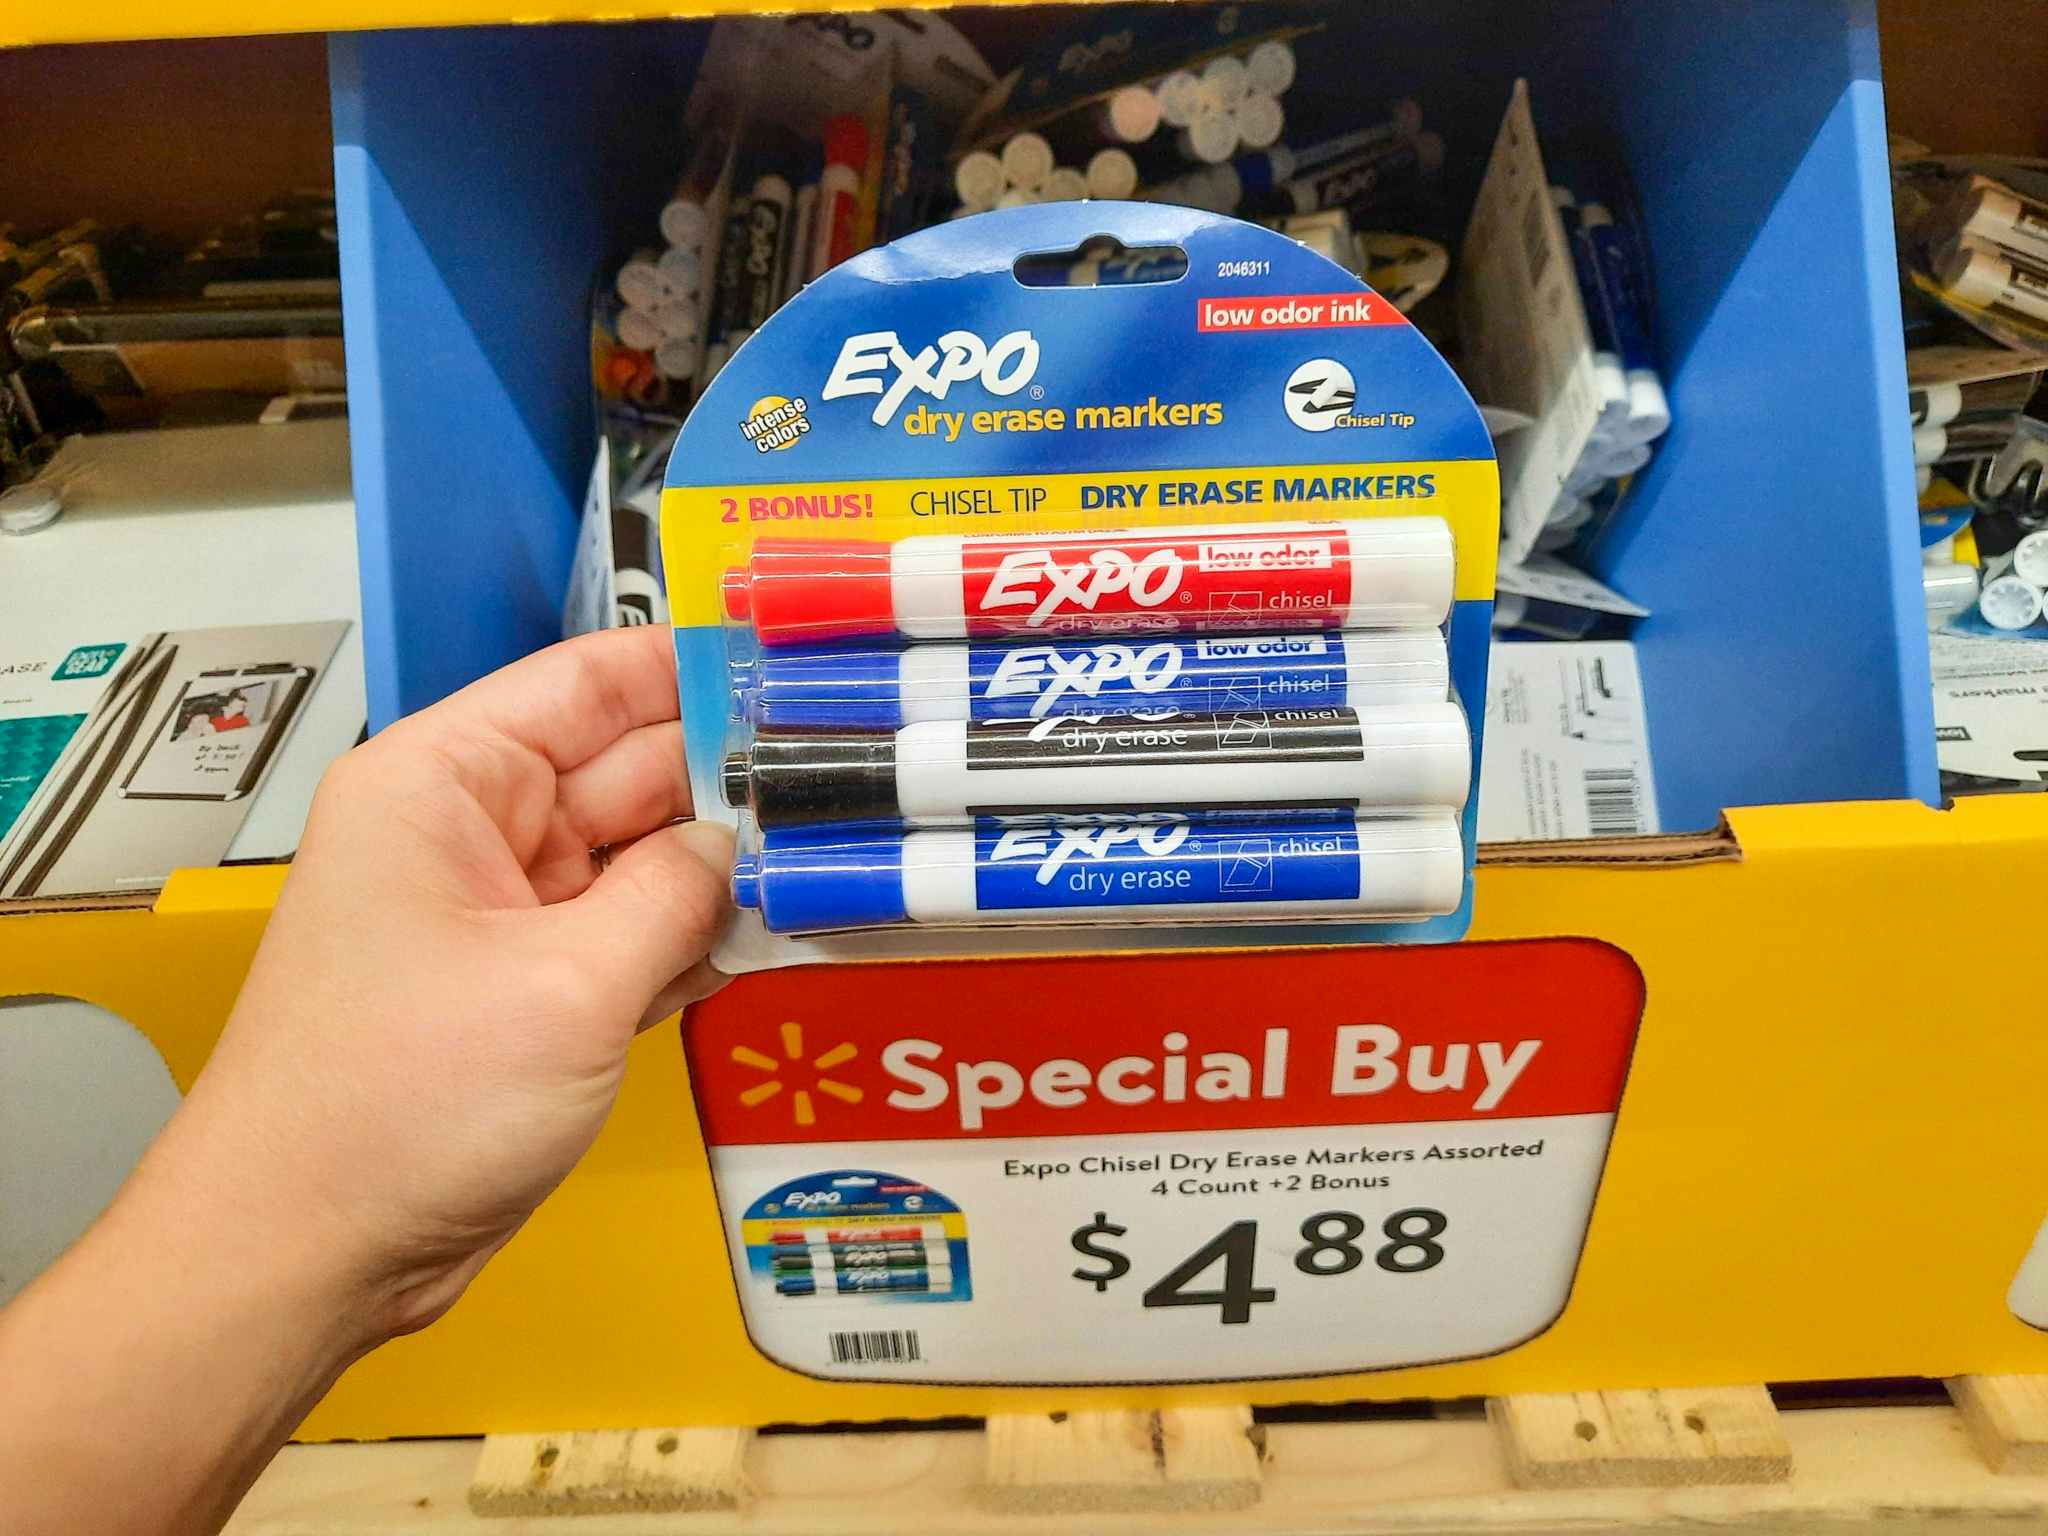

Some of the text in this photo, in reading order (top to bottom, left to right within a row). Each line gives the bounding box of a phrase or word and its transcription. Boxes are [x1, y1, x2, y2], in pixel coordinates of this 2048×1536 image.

[1218, 261, 1270, 277] 2046311
[1205, 299, 1371, 327] low odor ink
[822, 330, 1040, 427] EXPO
[740, 396, 807, 442] intense
[904, 396, 1224, 443] dry erase markers
[1335, 412, 1415, 428] Chisel Tip
[756, 418, 811, 454] colors
[721, 474, 1436, 523] 2 BONUS! CHISEL TIP DRY ERASE MARKERS
[1208, 544, 1320, 568] low odor
[980, 548, 1185, 627] EXPO
[1269, 589, 1333, 610] chisel
[984, 642, 1183, 717] EXPO
[1267, 673, 1331, 694] chisel
[1274, 708, 1340, 721] chisel
[1062, 728, 1188, 753] dry erase
[1278, 836, 1343, 857] chisel
[1070, 866, 1192, 896] dry erase
[880, 1023, 1543, 1130] Special Buy
[1004, 1139, 1544, 1180] Expo Chisel Dry Erase Markers Assorted
[1151, 1172, 1390, 1197] 4 Count +2 Bonus
